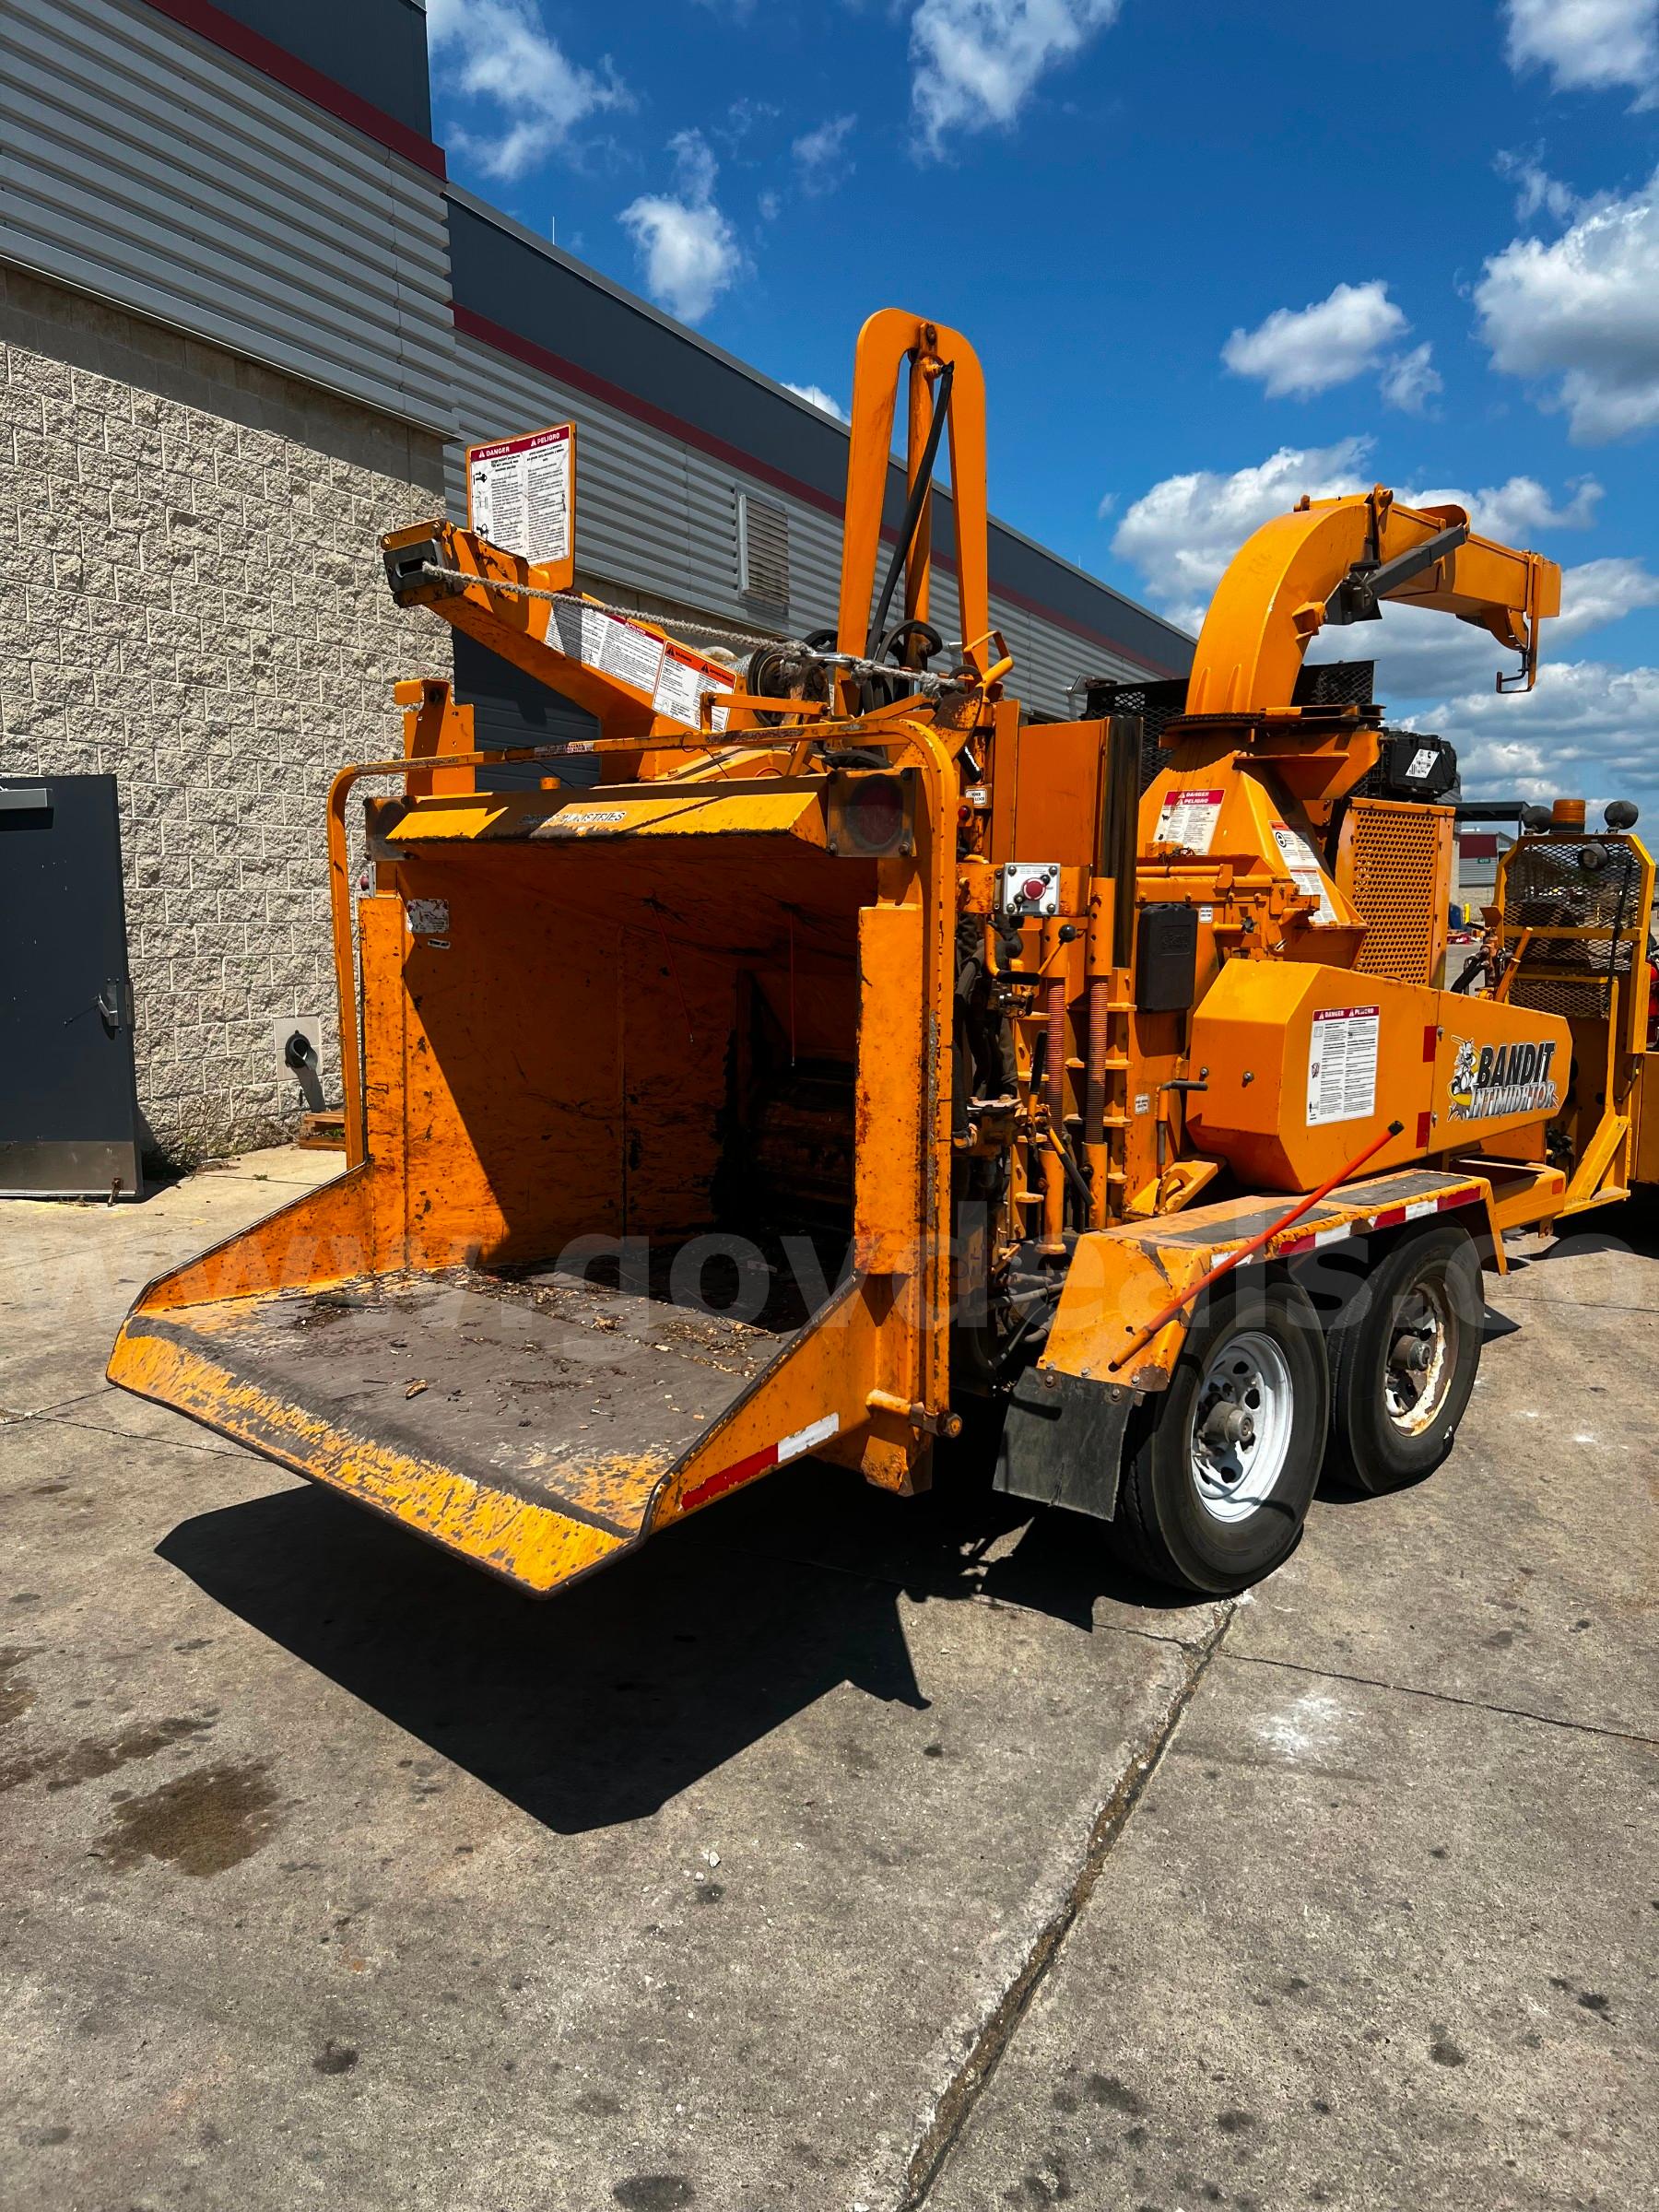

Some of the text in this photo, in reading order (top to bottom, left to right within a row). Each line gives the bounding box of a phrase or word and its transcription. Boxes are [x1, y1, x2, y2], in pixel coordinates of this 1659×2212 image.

[537, 432, 560, 445] PELIGRO
[486, 446, 510, 457] DANGER
[1324, 1010, 1345, 1018] DANGER
[1477, 1041, 1556, 1088] BANDIT
[1467, 1081, 1556, 1120] INTIMIDATOR
